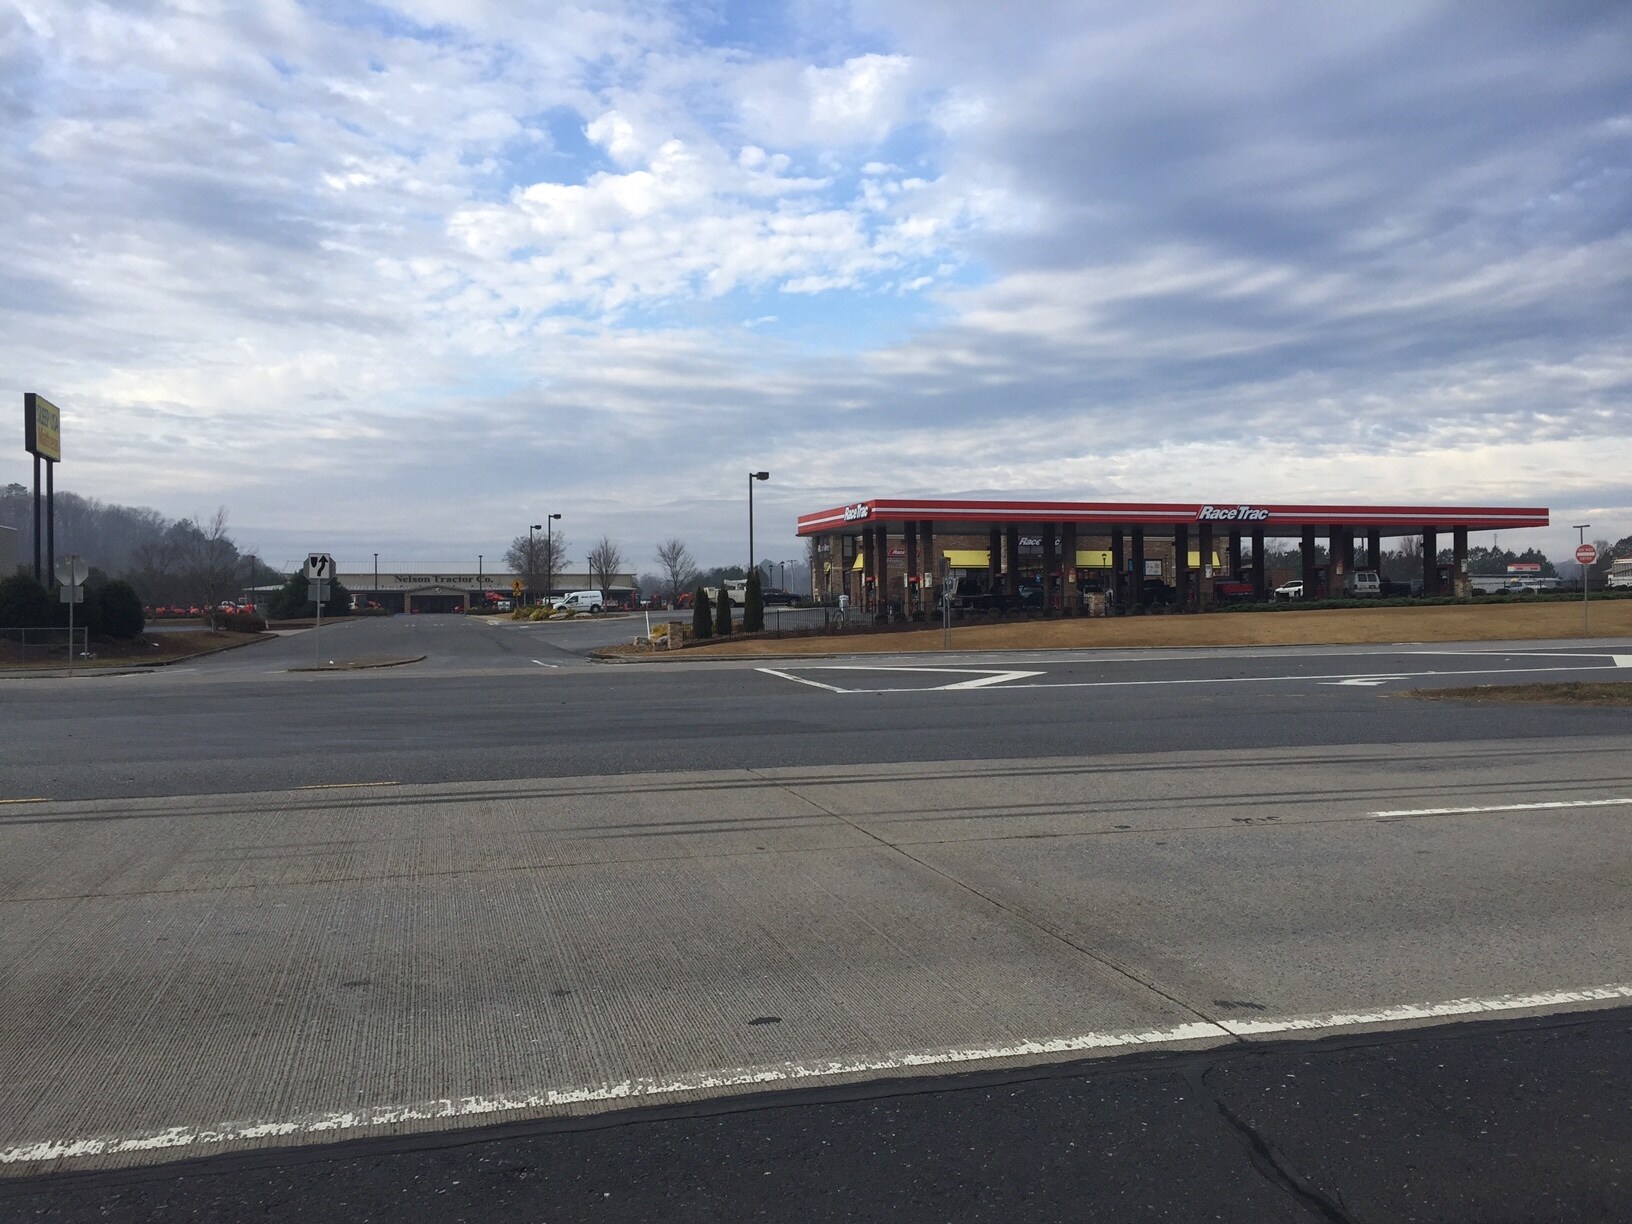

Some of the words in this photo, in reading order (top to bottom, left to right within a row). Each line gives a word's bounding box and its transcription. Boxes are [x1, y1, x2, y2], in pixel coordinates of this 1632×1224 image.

[1198, 505, 1269, 520] RaceTrac
[394, 575, 431, 583] Nelson
[433, 575, 474, 583] Tractor
[476, 575, 494, 583] Co.
